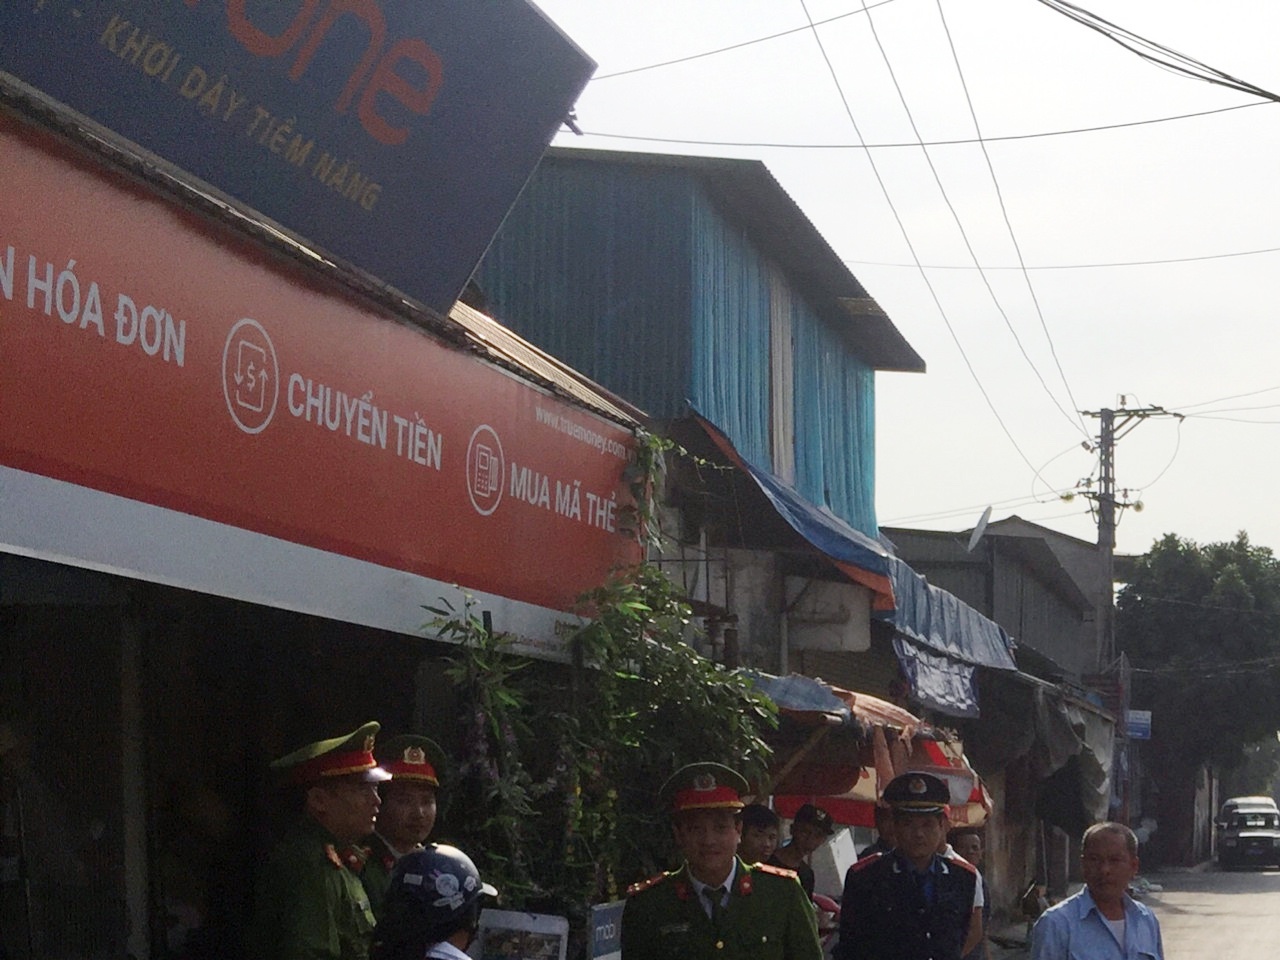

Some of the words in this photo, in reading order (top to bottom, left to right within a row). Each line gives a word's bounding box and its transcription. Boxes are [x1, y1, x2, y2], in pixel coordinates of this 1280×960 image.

[184, 0, 444, 145] one
[27, 258, 105, 337] HÓA
[114, 292, 187, 368] ĐƠN
[287, 372, 388, 450] CHUYỂN
[393, 411, 442, 471] TIỀN
[509, 462, 551, 511] MUA
[554, 479, 582, 522] MÃ
[585, 491, 618, 534] THẺ
